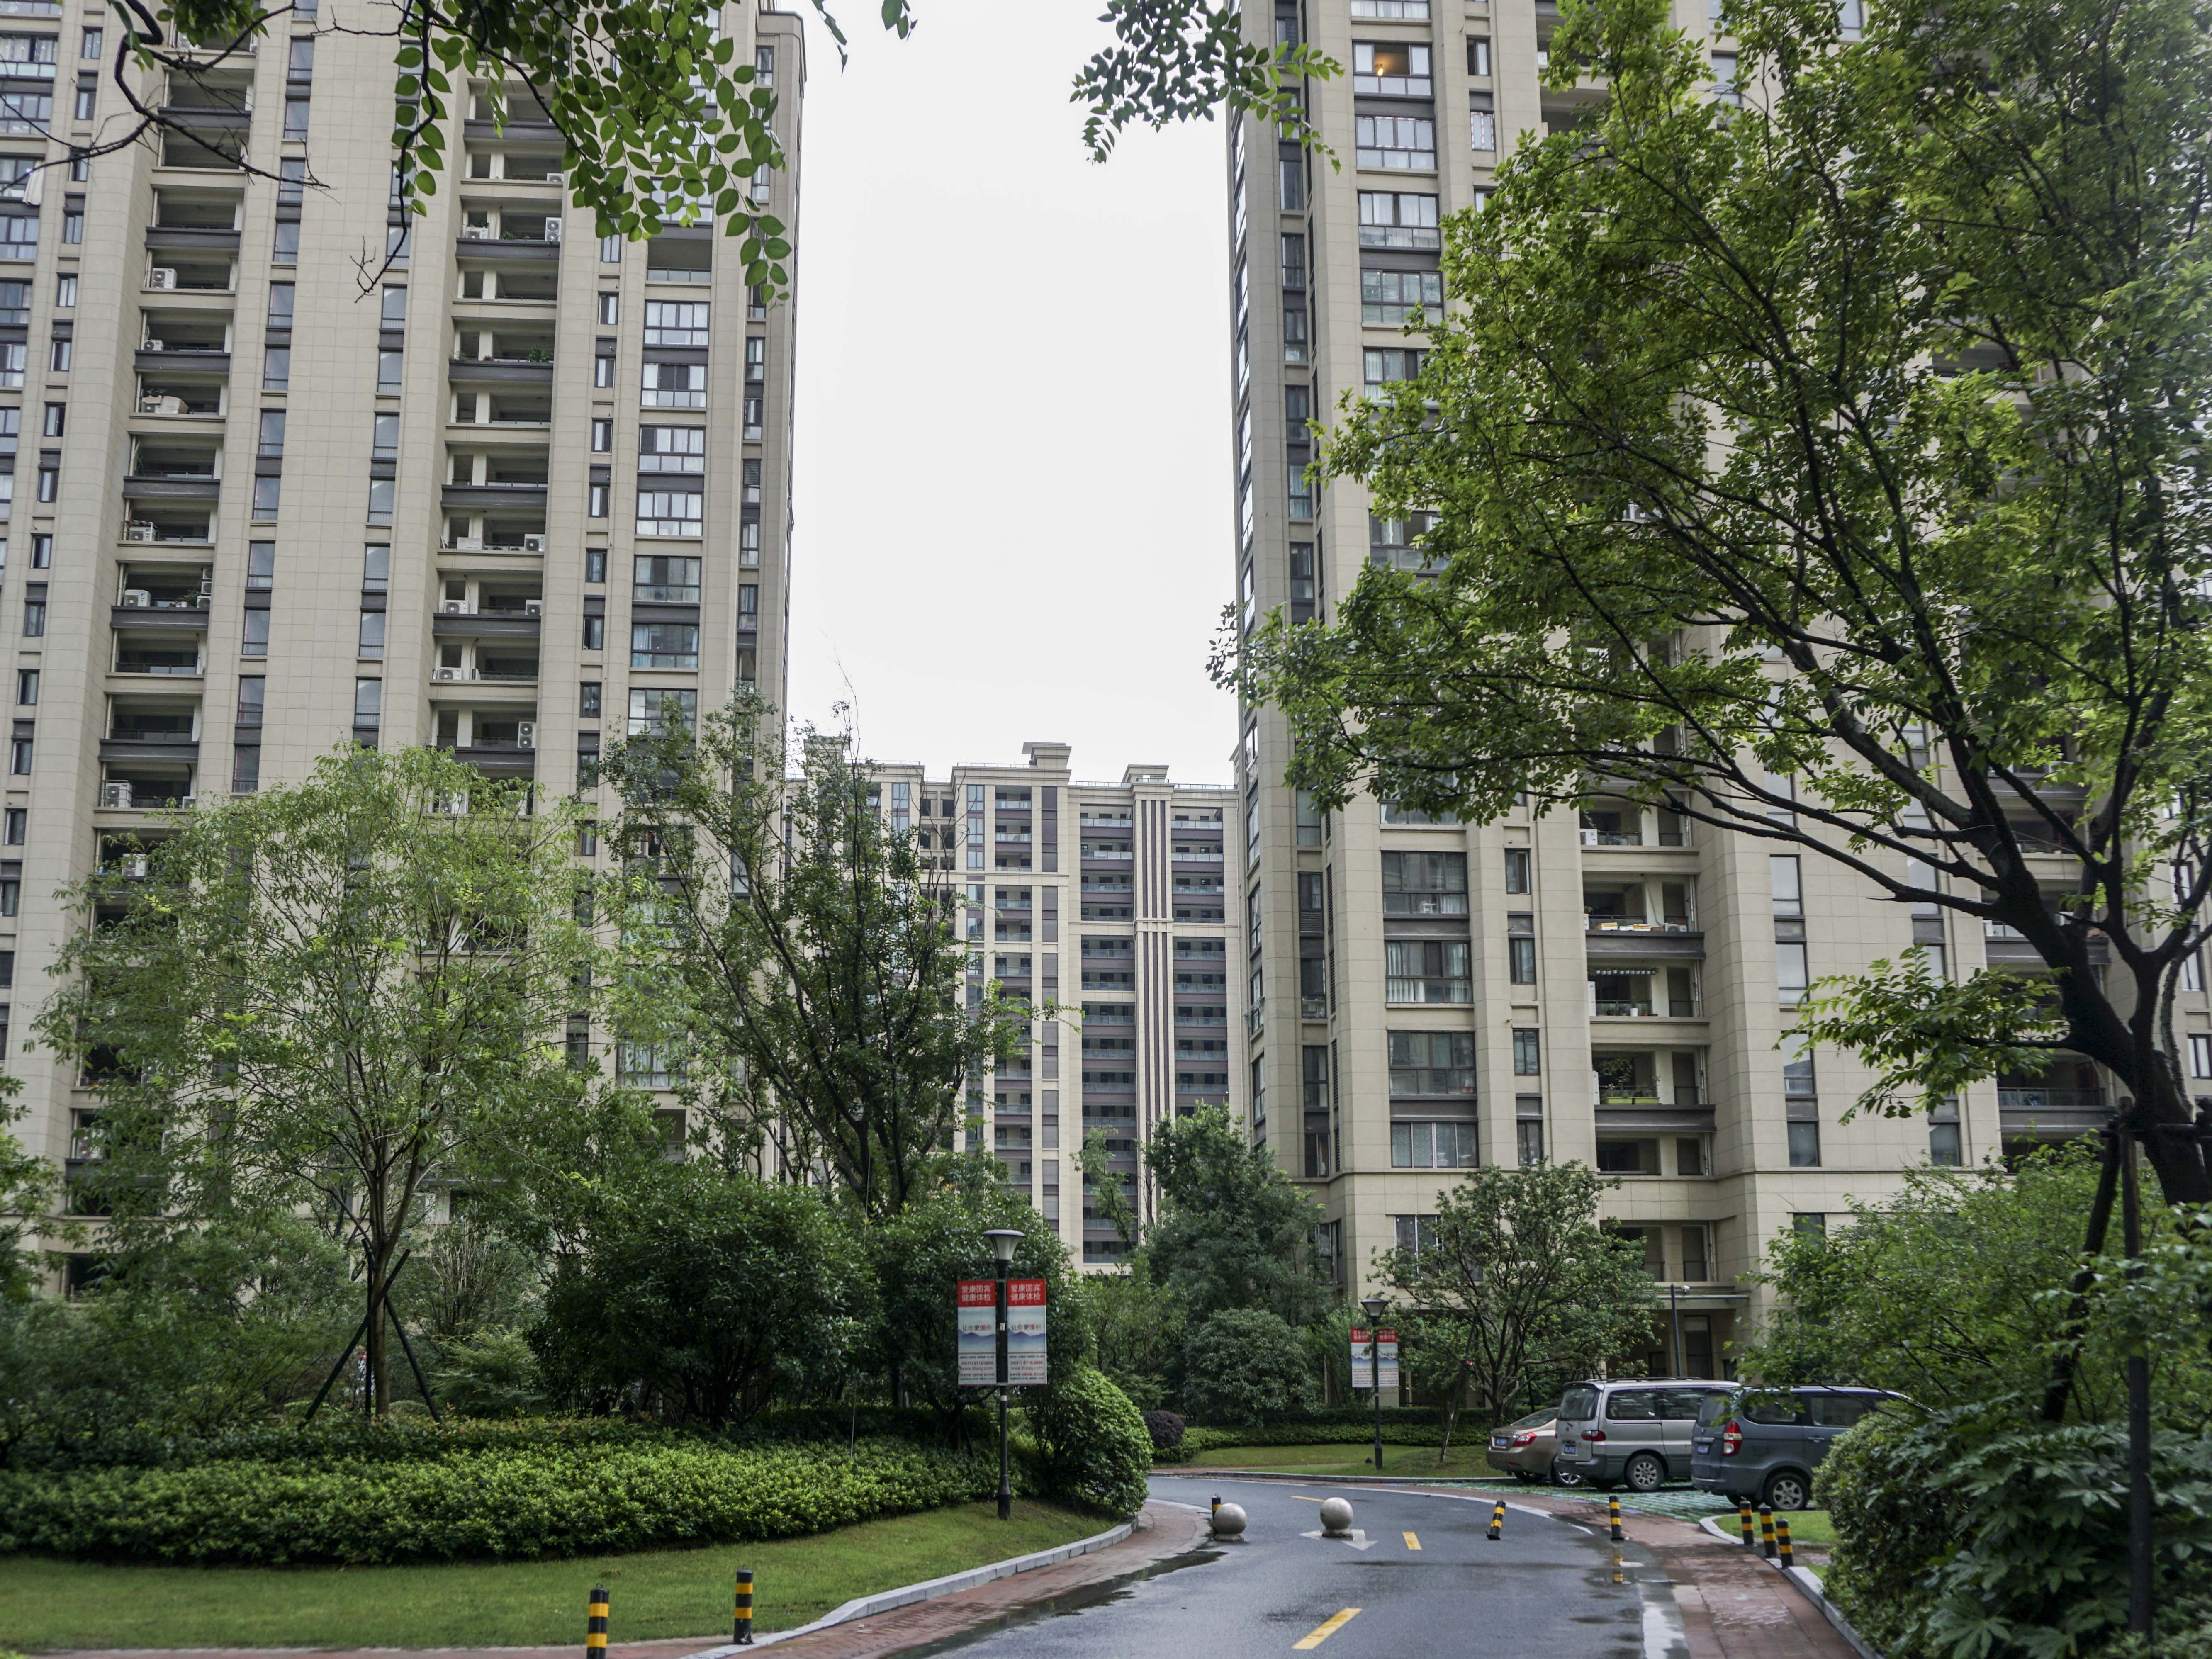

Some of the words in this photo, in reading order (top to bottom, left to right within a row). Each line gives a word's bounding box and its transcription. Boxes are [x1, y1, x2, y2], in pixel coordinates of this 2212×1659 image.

[962, 1285, 991, 1293] 爱康国宾
[1011, 1284, 1041, 1292] 爱康国宾
[962, 1293, 991, 1301] 健康体检
[1011, 1292, 1041, 1301] 健康体检
